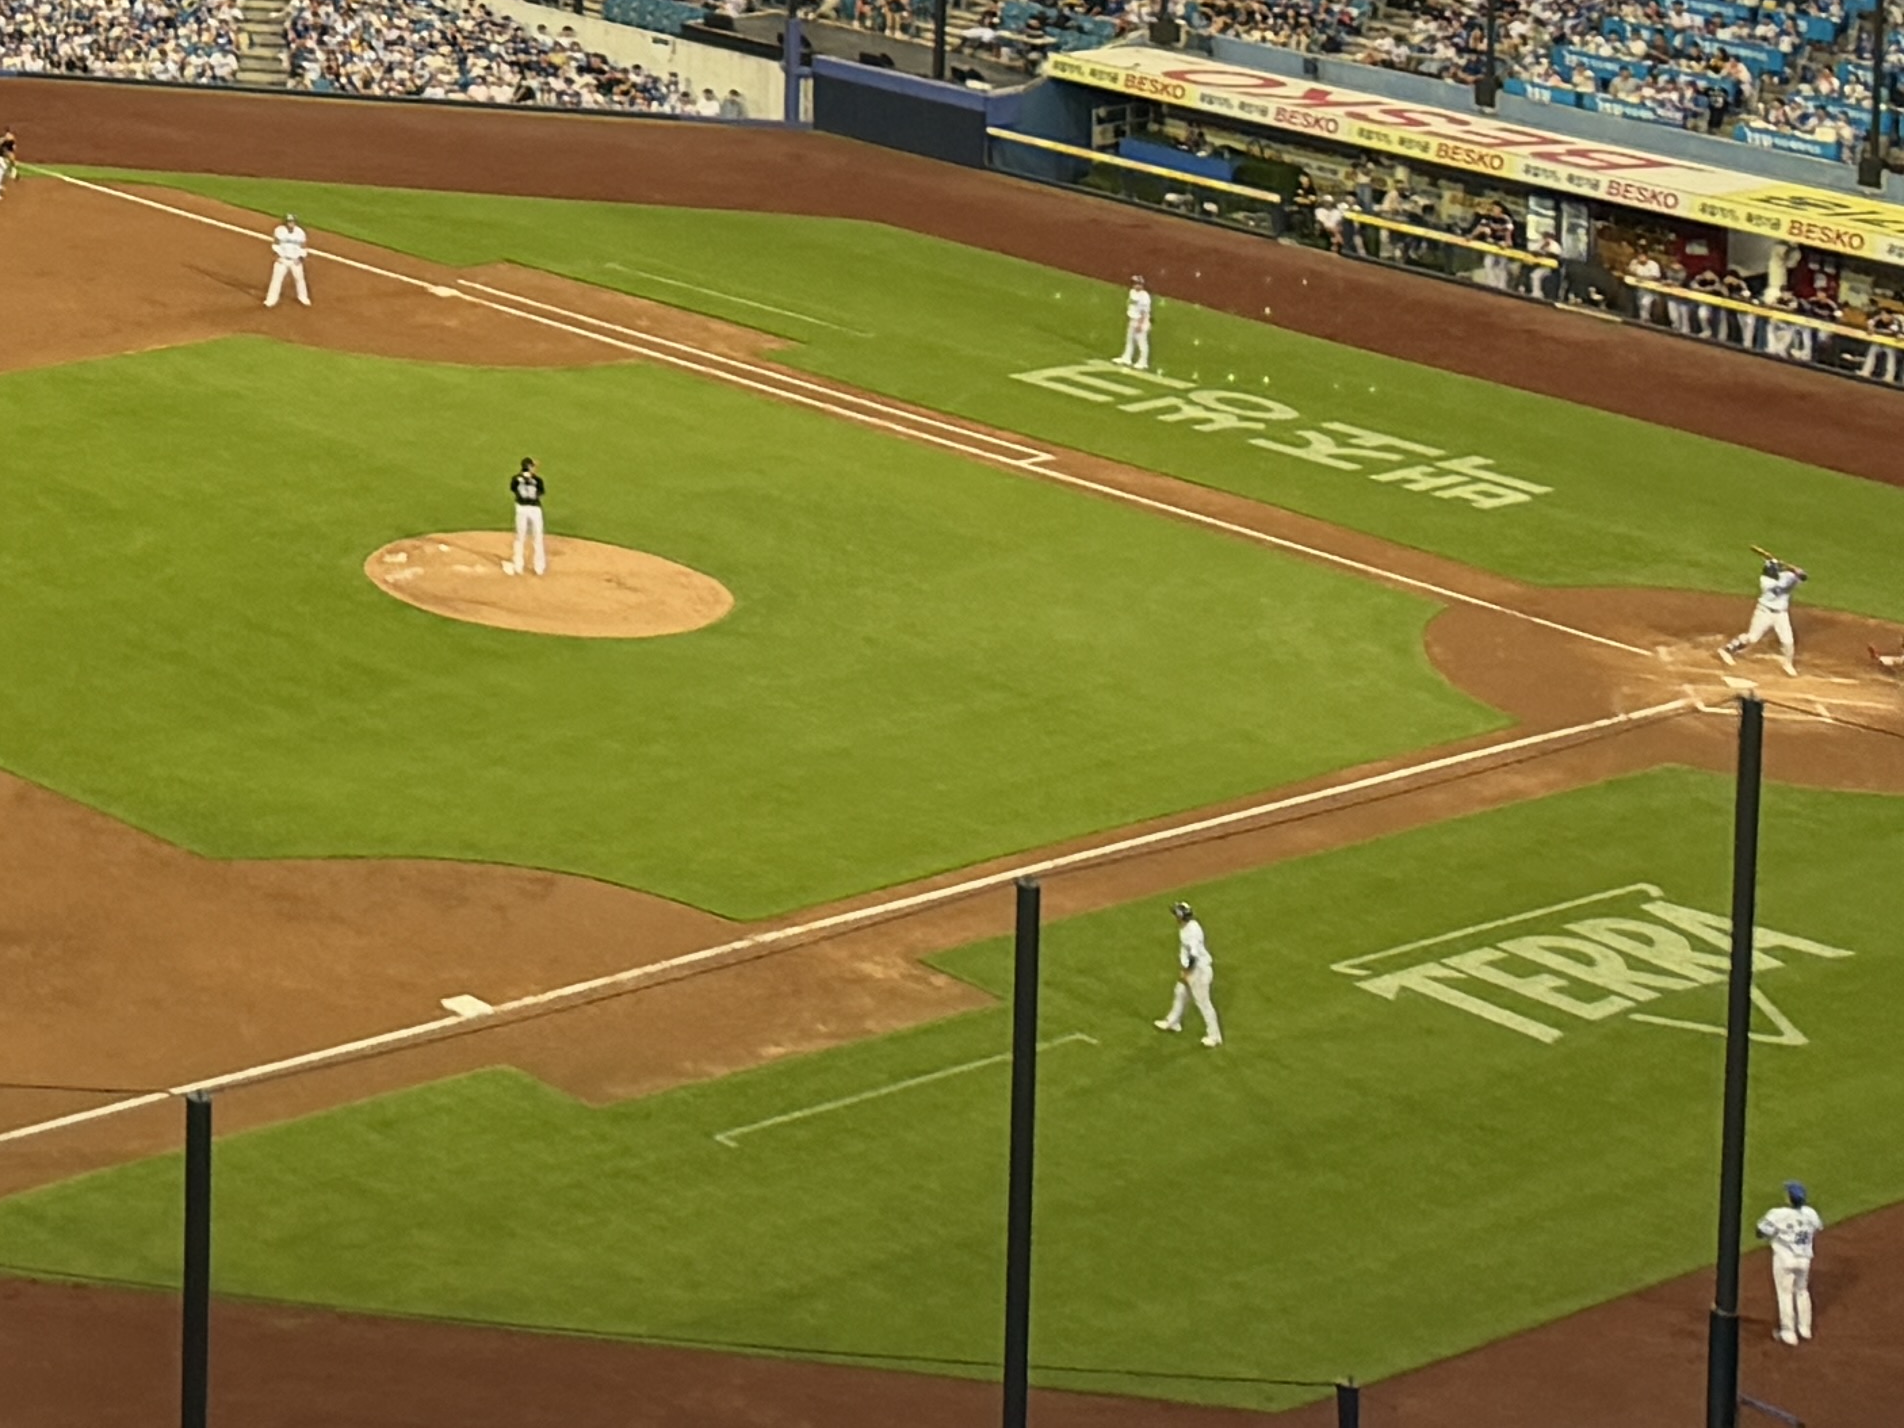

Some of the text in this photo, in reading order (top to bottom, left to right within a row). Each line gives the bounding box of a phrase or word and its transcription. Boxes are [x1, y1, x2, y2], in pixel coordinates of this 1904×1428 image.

[1124, 73, 1186, 100] BESKO
[1273, 107, 1339, 134] BESKO
[1435, 142, 1504, 172] BESKO
[1605, 179, 1679, 210] BESKO
[1788, 219, 1865, 252] BESKO
[1007, 358, 1555, 511] 백조씽크
[1353, 900, 1855, 1044] TERRA
